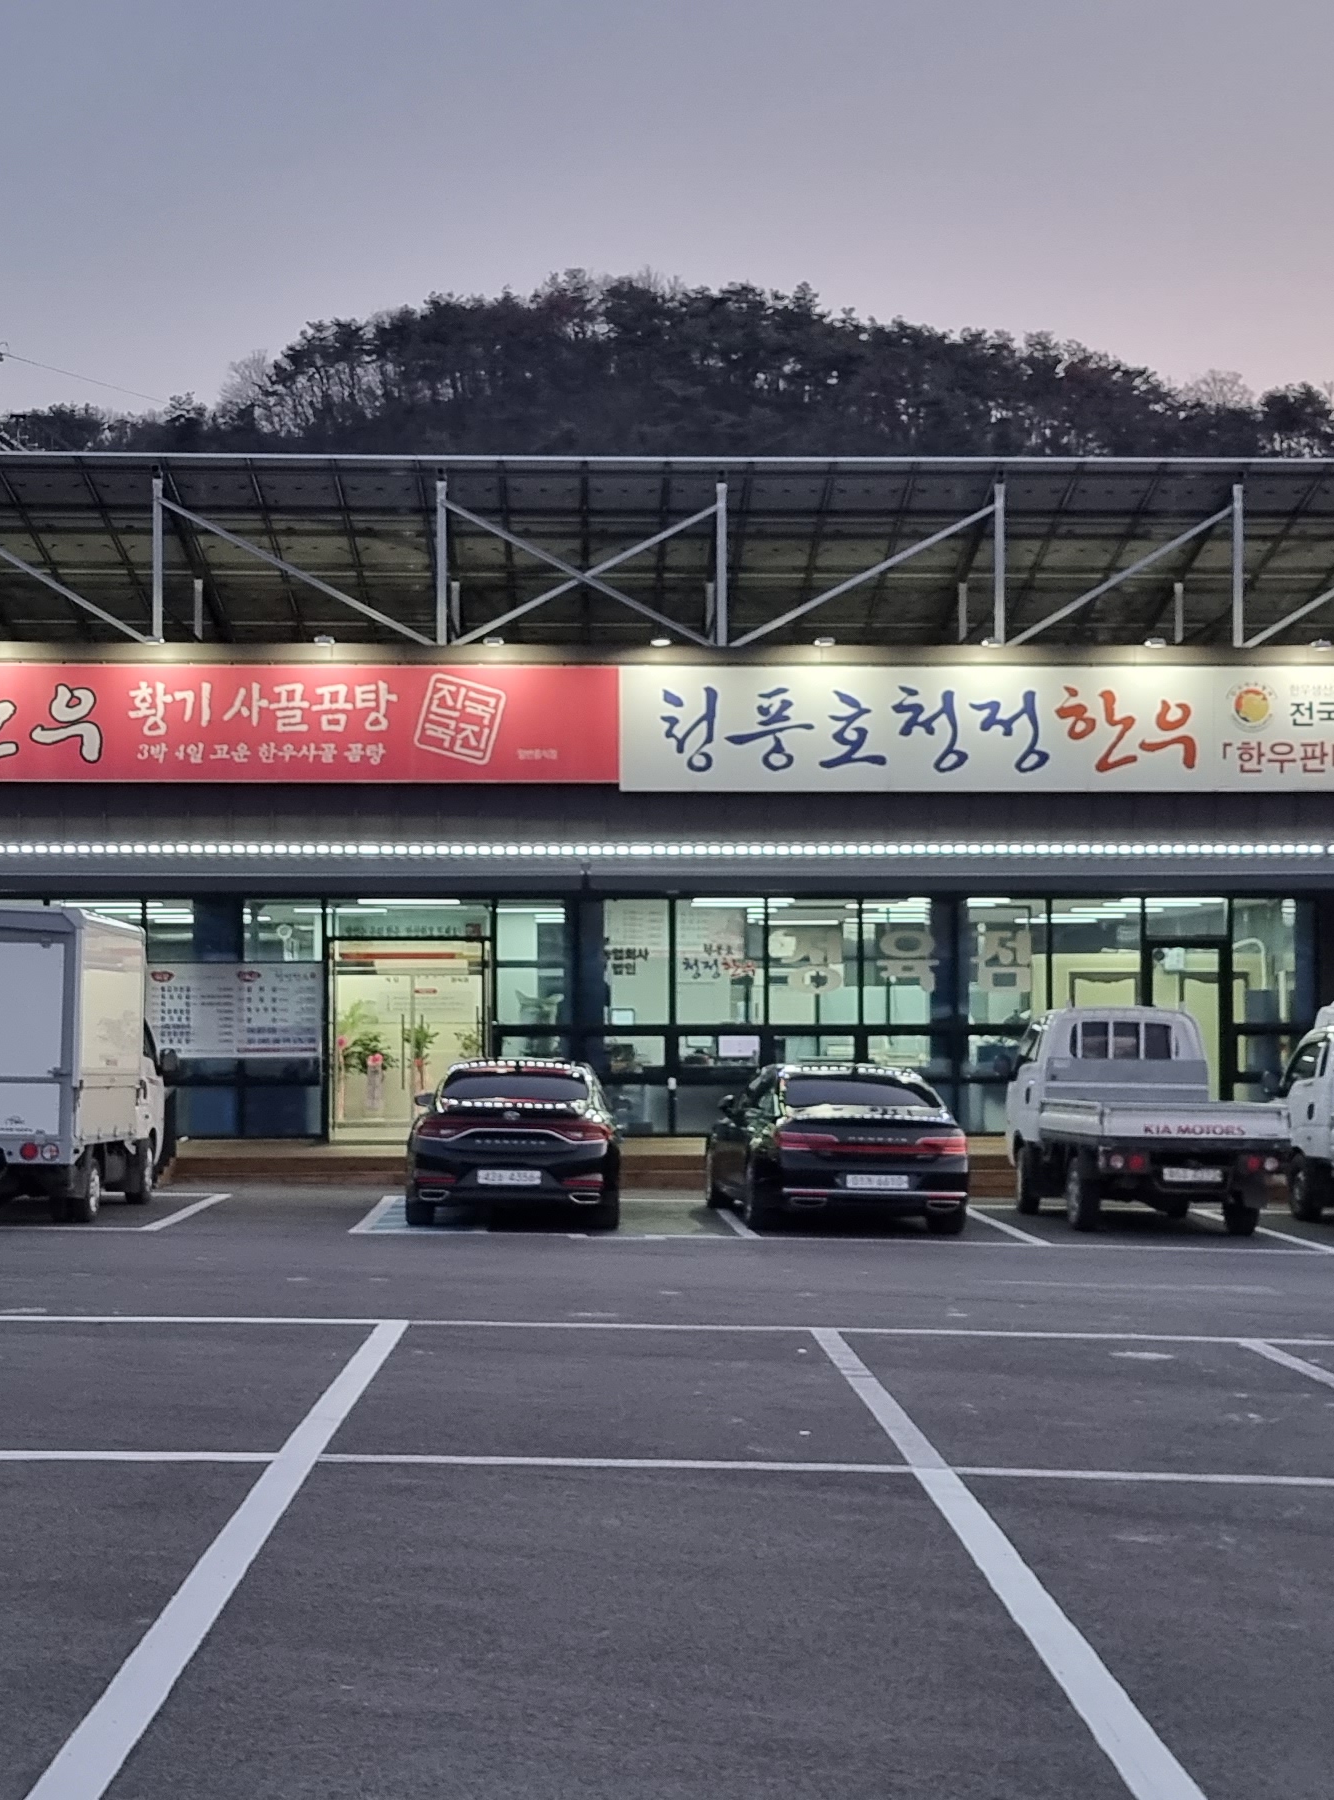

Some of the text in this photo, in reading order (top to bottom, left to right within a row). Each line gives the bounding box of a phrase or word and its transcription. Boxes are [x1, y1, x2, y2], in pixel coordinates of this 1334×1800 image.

[127, 680, 399, 736] 황기 사골곰탕
[137, 742, 168, 764] 3박
[258, 742, 337, 764] 한우사골
[344, 742, 387, 765] 곰탕
[1143, 1123, 1246, 1136] KIA MOTORS
